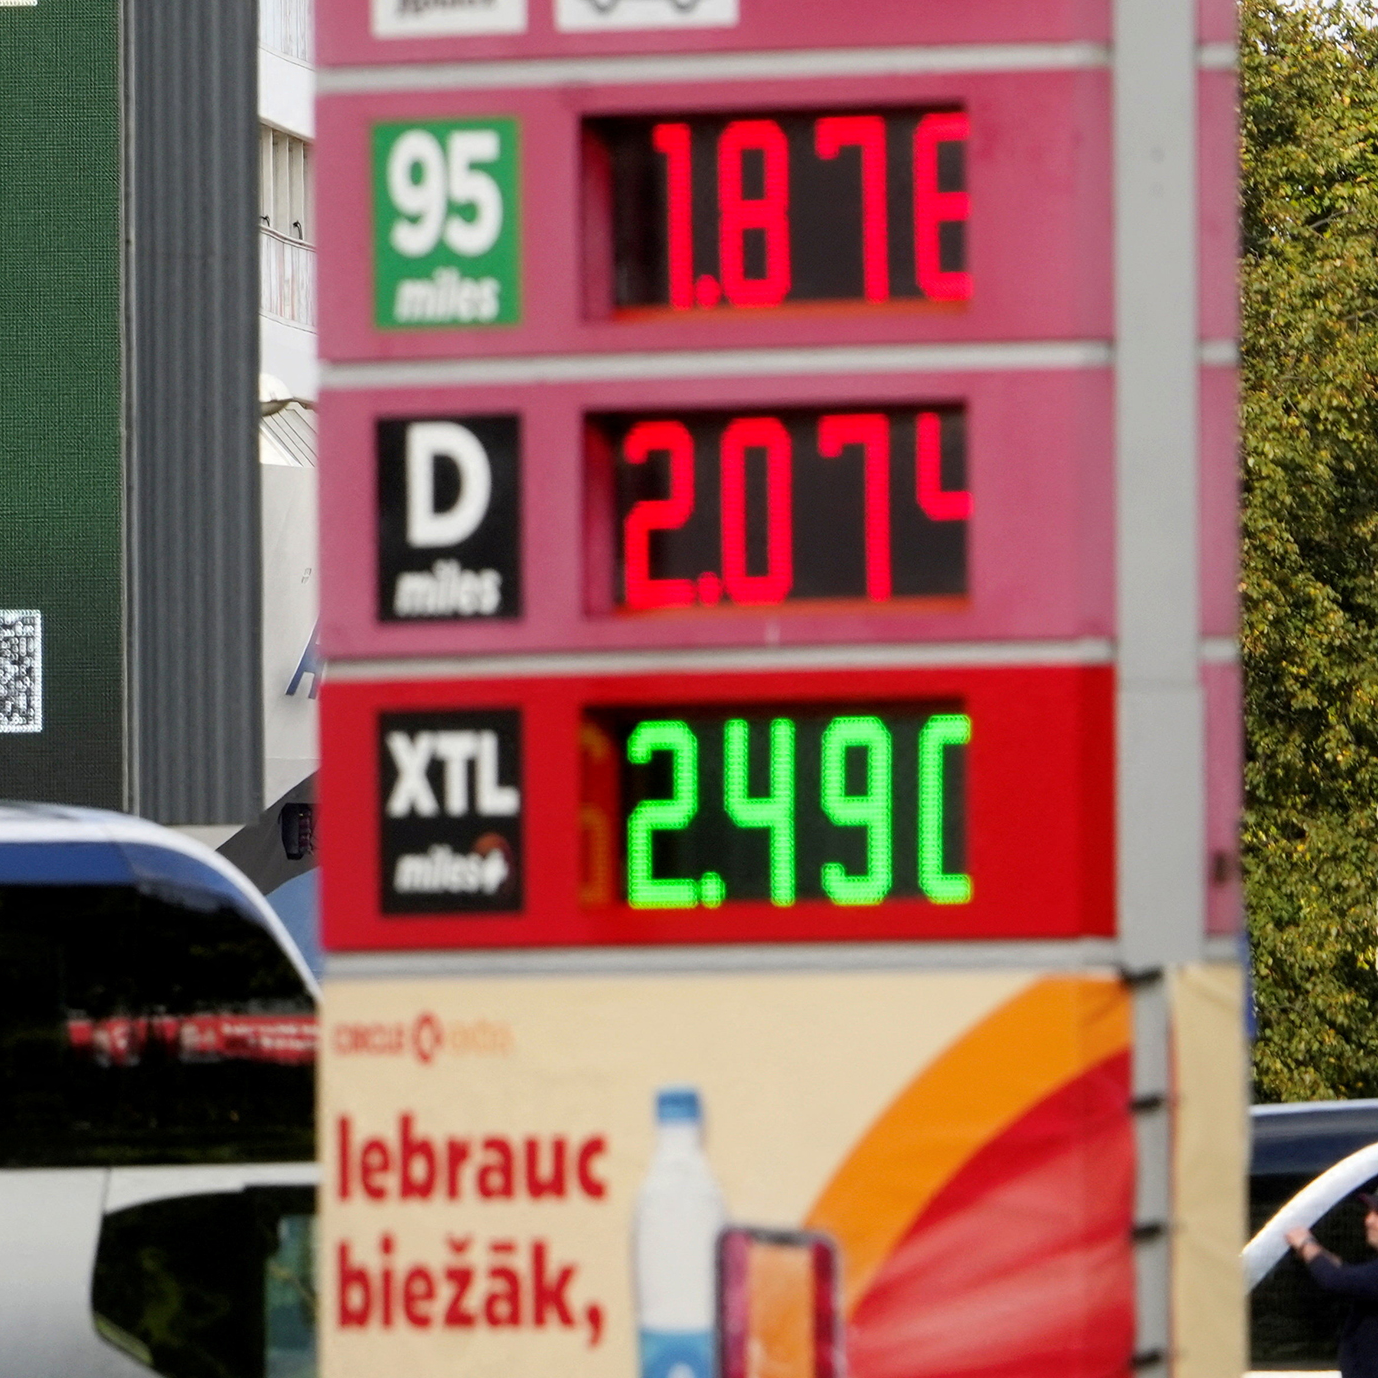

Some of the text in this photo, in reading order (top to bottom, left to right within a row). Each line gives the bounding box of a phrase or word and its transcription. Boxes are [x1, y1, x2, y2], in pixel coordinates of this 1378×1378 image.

[386, 128, 504, 258] 95
[393, 266, 501, 324] miles
[405, 421, 493, 549] D
[393, 561, 503, 618] miles
[385, 730, 521, 818] XTL
[335, 1234, 606, 1348] biežāk,
